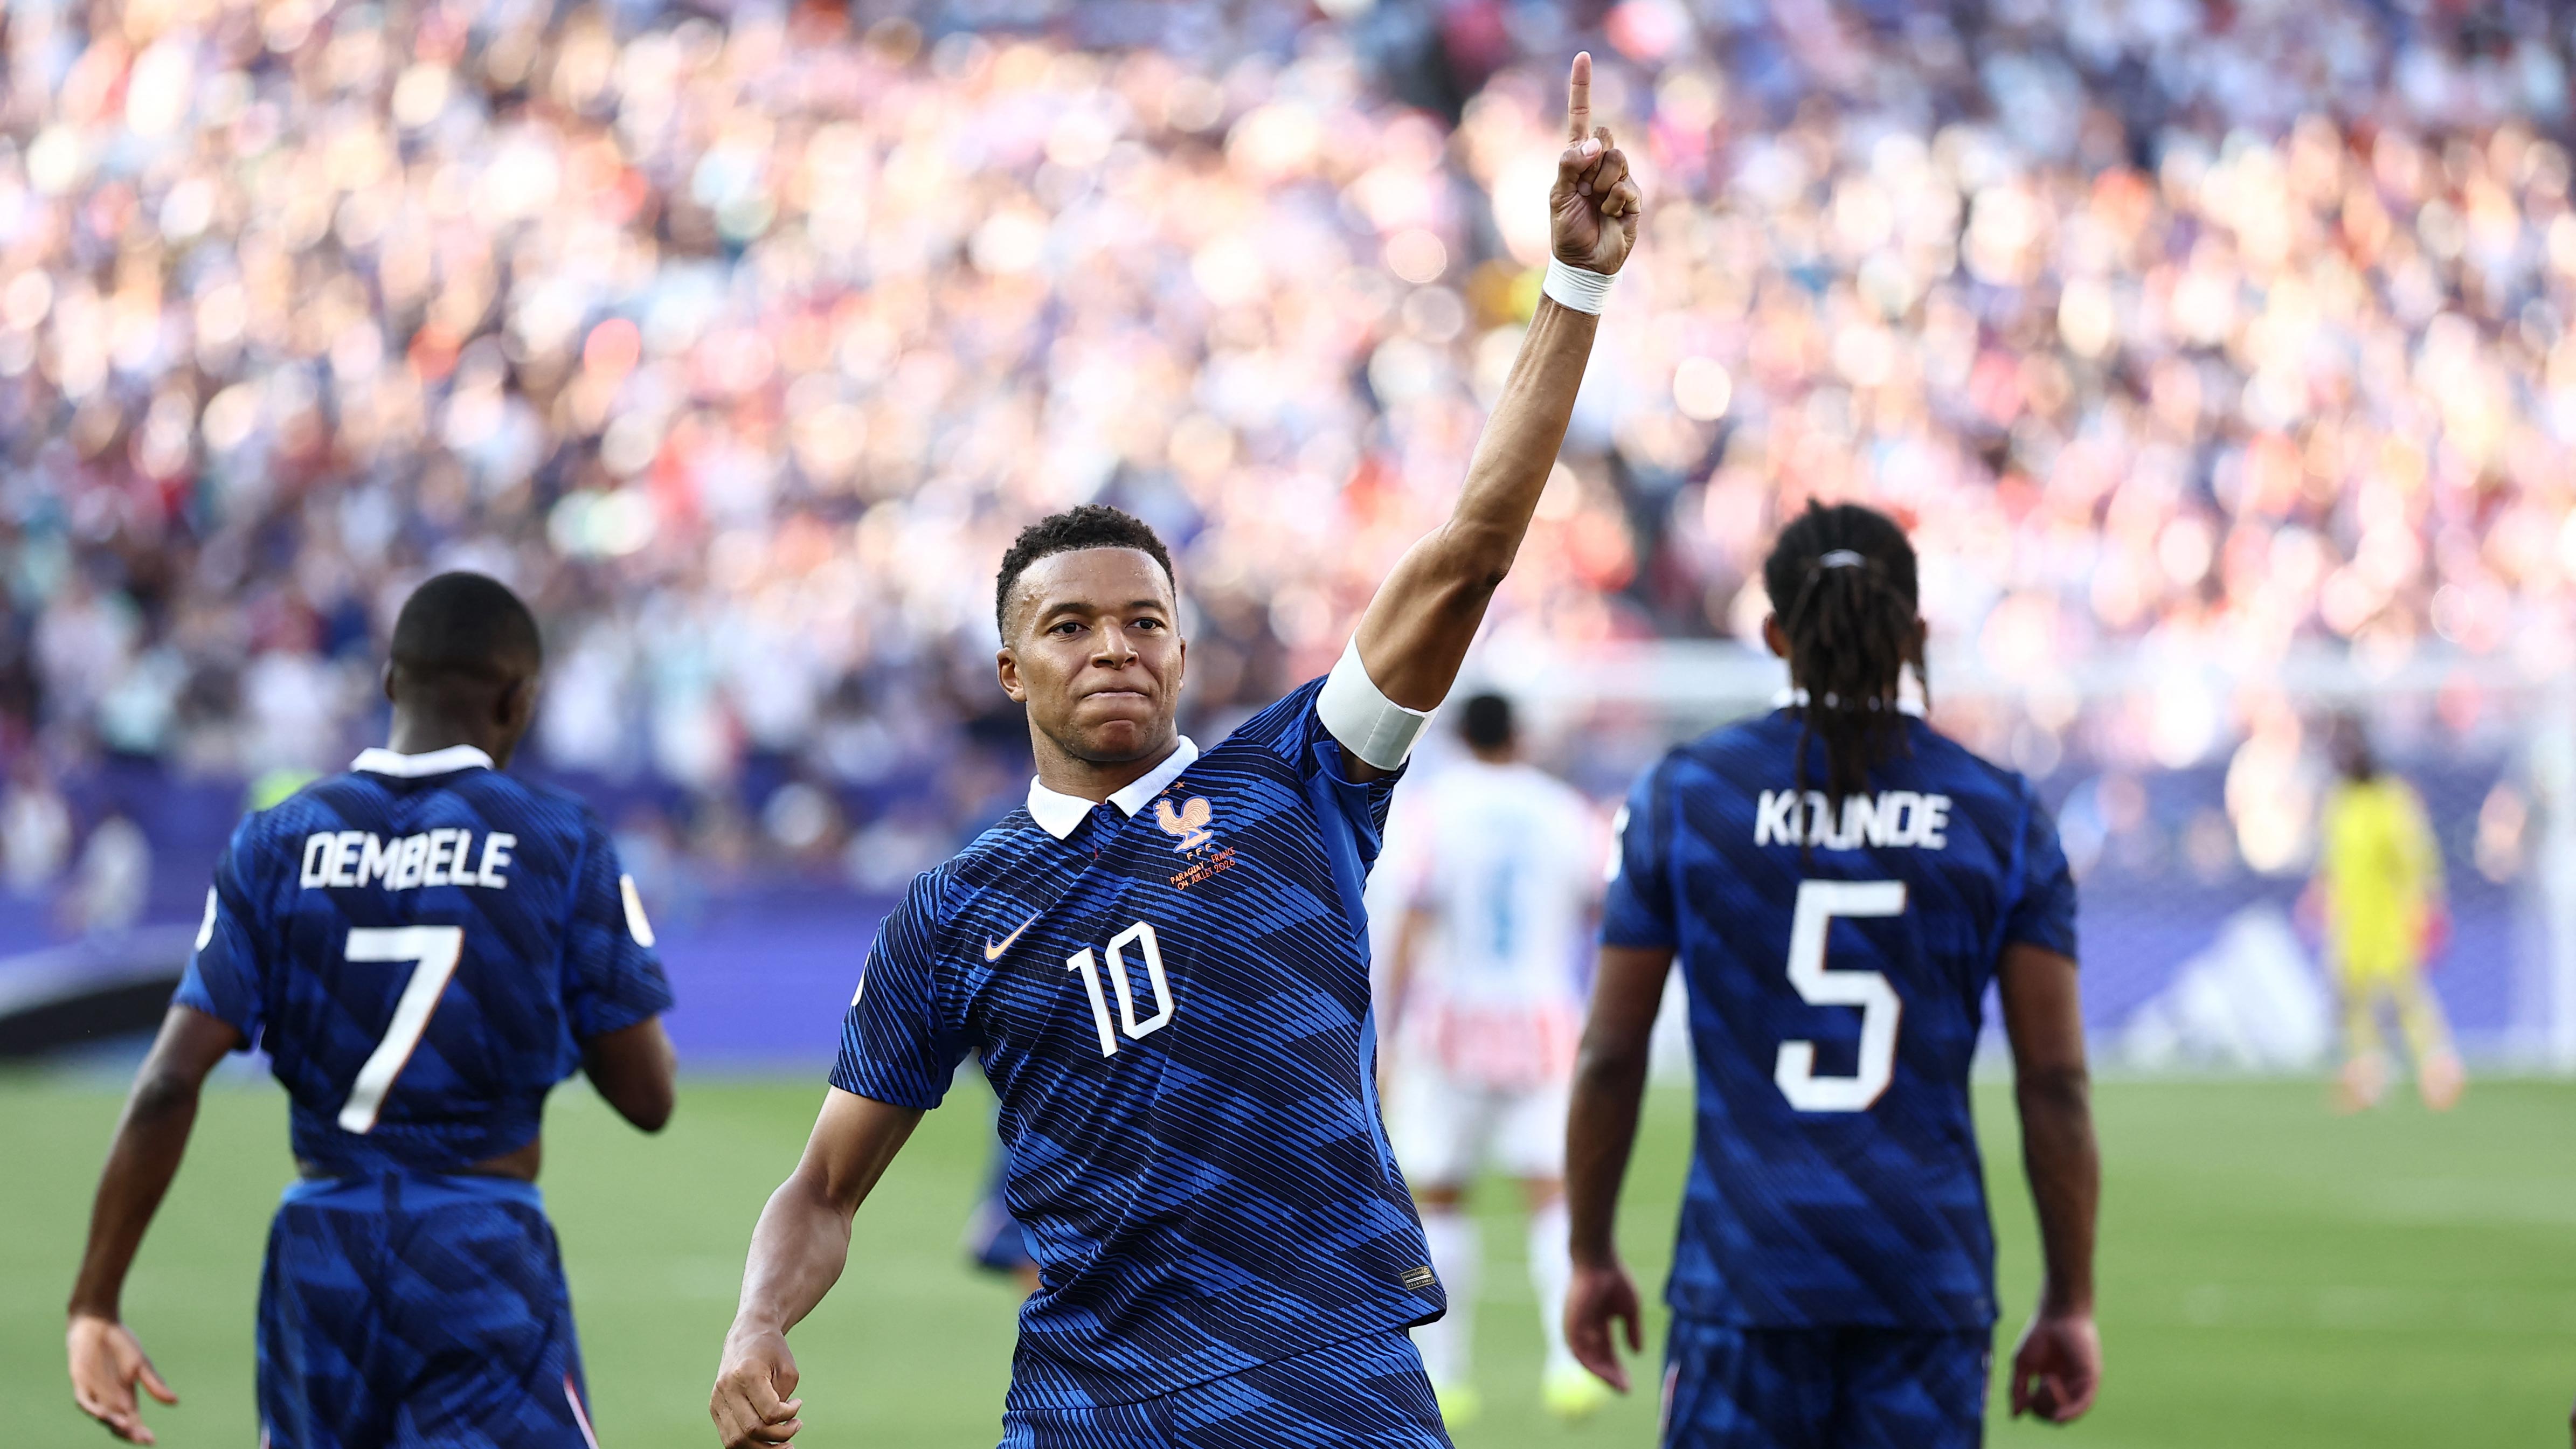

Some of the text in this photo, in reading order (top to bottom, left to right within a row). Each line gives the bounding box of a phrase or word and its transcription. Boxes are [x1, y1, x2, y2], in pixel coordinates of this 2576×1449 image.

[1754, 789, 1952, 851] KOUNDE
[300, 827, 518, 891] DEMBELE
[1171, 861, 1204, 884] PARAGUAY
[1211, 847, 1236, 863] FRANCE
[1178, 859, 1235, 890] 04 JUILLET 2026
[1066, 920, 1175, 1058] 10
[1774, 879, 1908, 1112] 5
[337, 925, 465, 1134] 7
